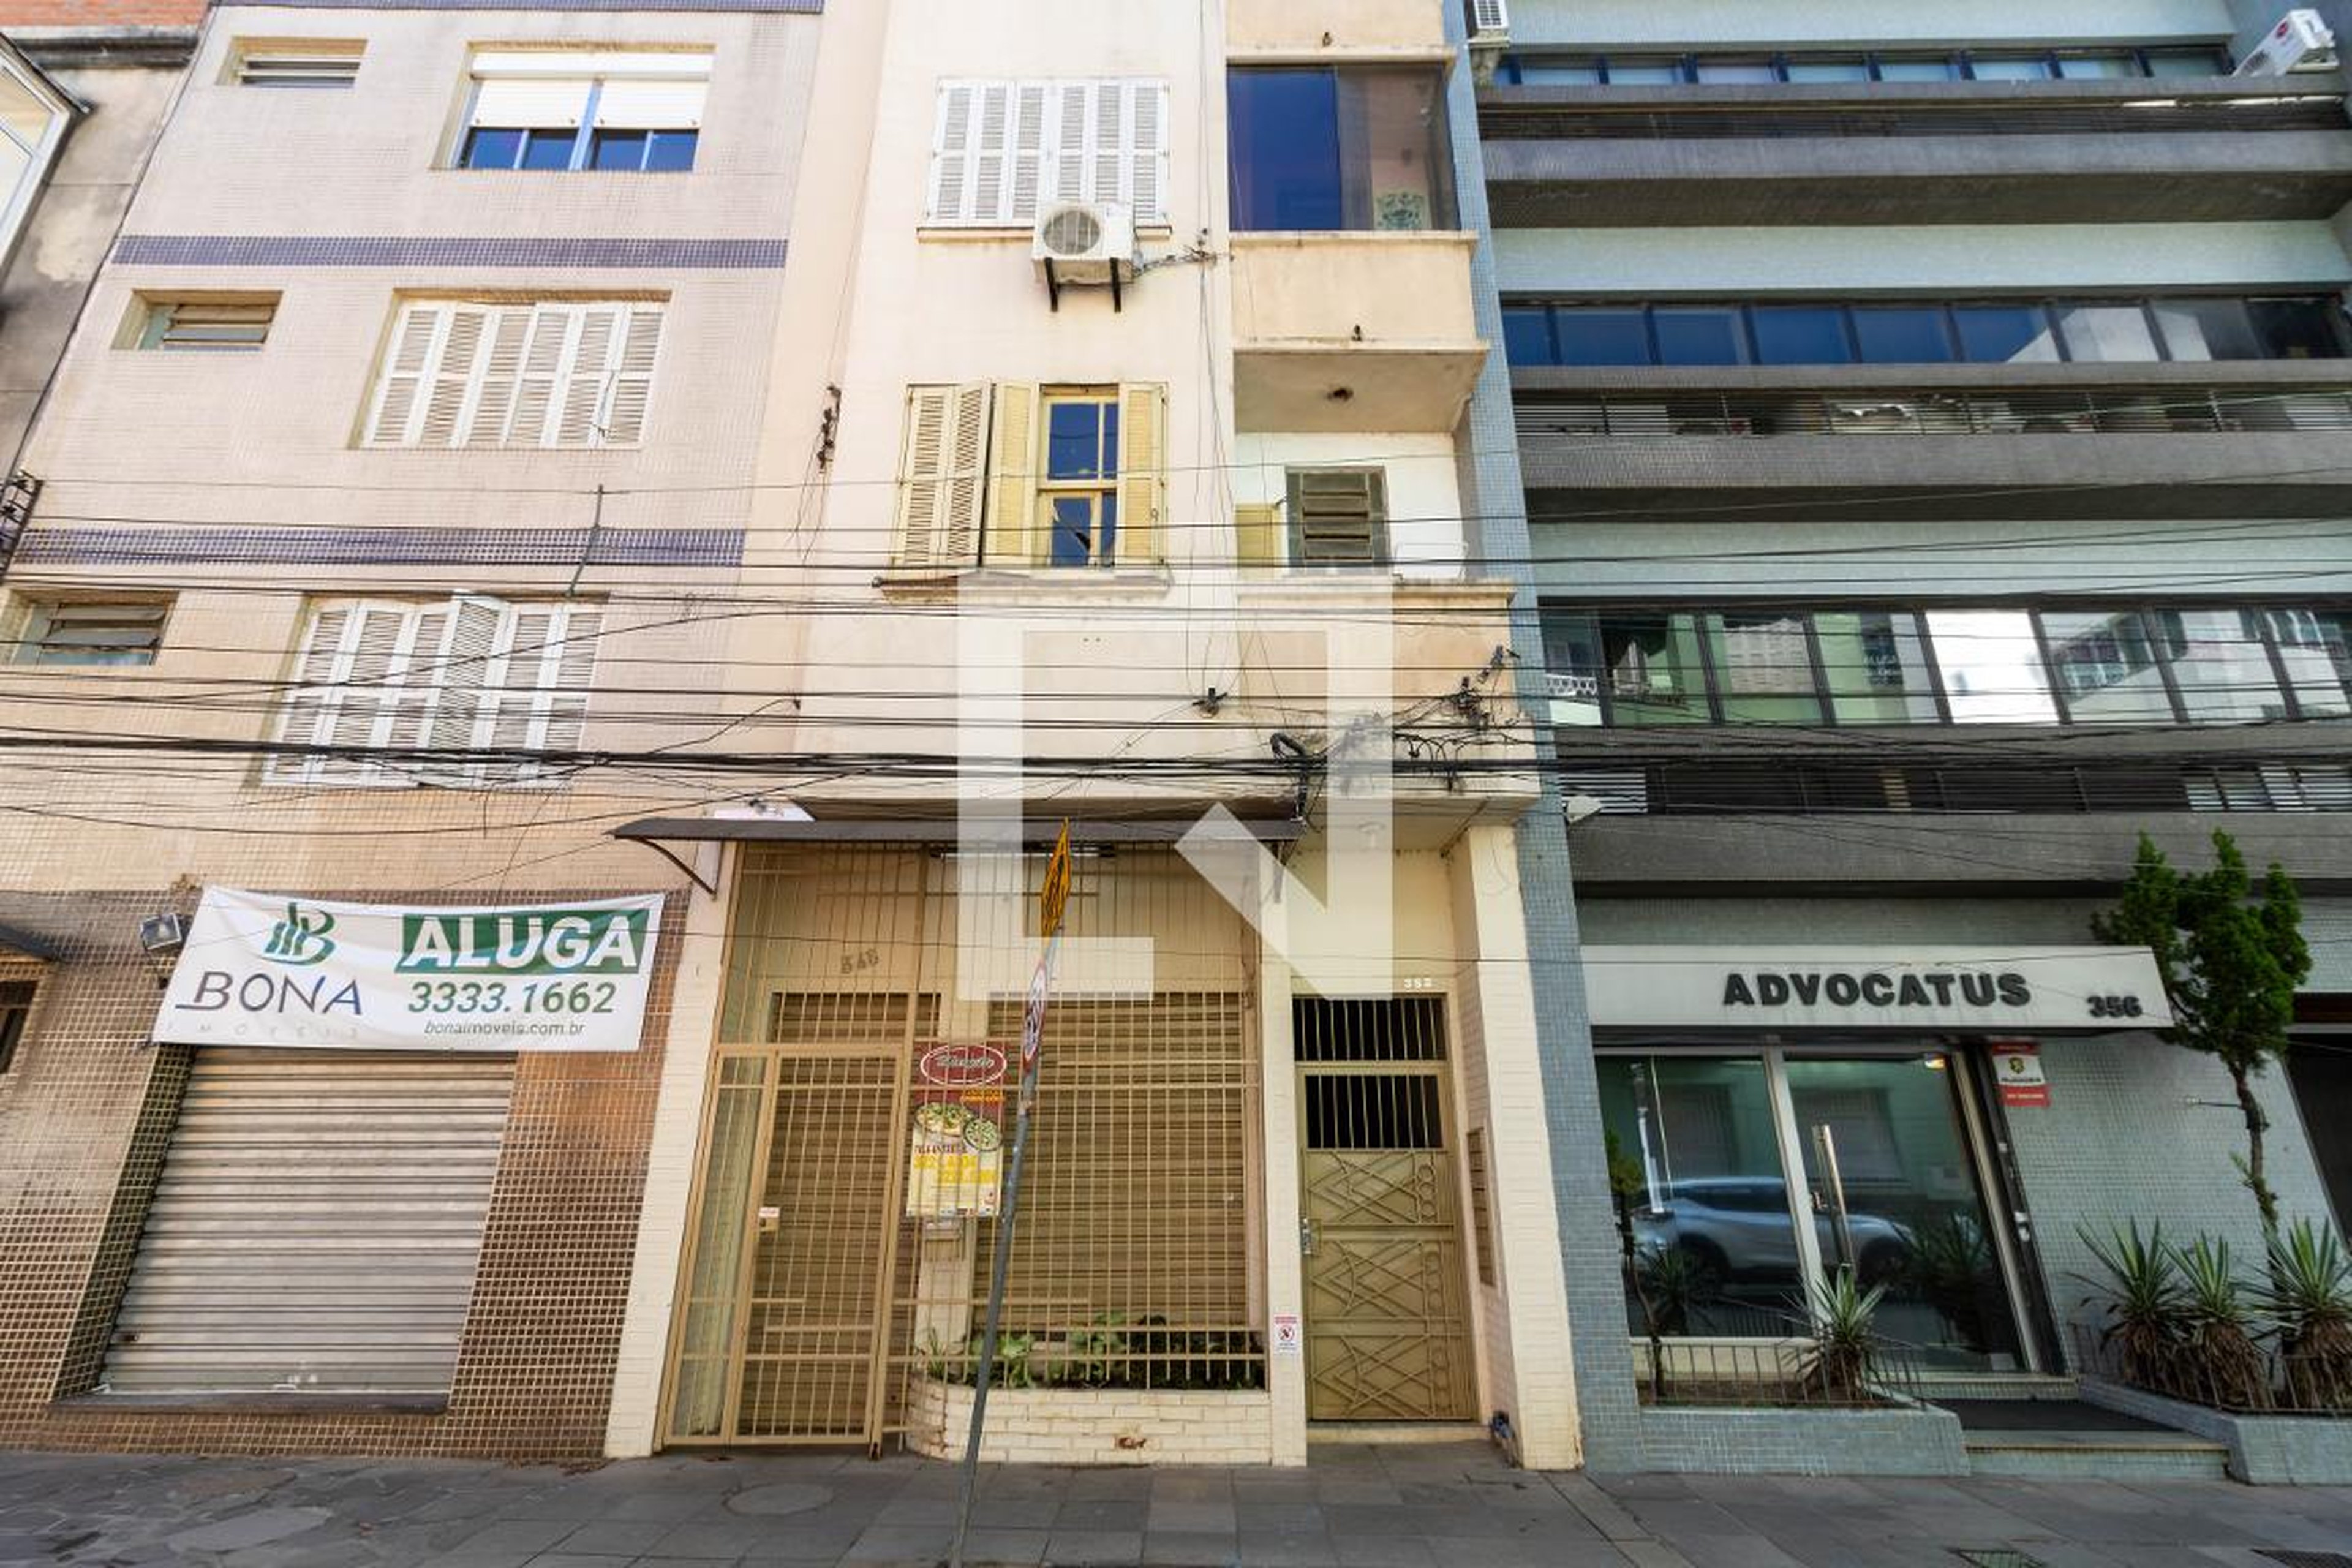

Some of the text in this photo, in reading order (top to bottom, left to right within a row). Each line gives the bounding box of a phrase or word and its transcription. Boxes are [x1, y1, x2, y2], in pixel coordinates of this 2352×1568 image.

[401, 915, 638, 968] ALUGA
[175, 971, 363, 1015] BONA
[408, 981, 617, 1014] 3333.1662
[1723, 973, 2031, 1007] ADVOCATUS
[2087, 996, 2143, 1018] 356
[424, 1020, 586, 1036] bonaimoveis.com.br
